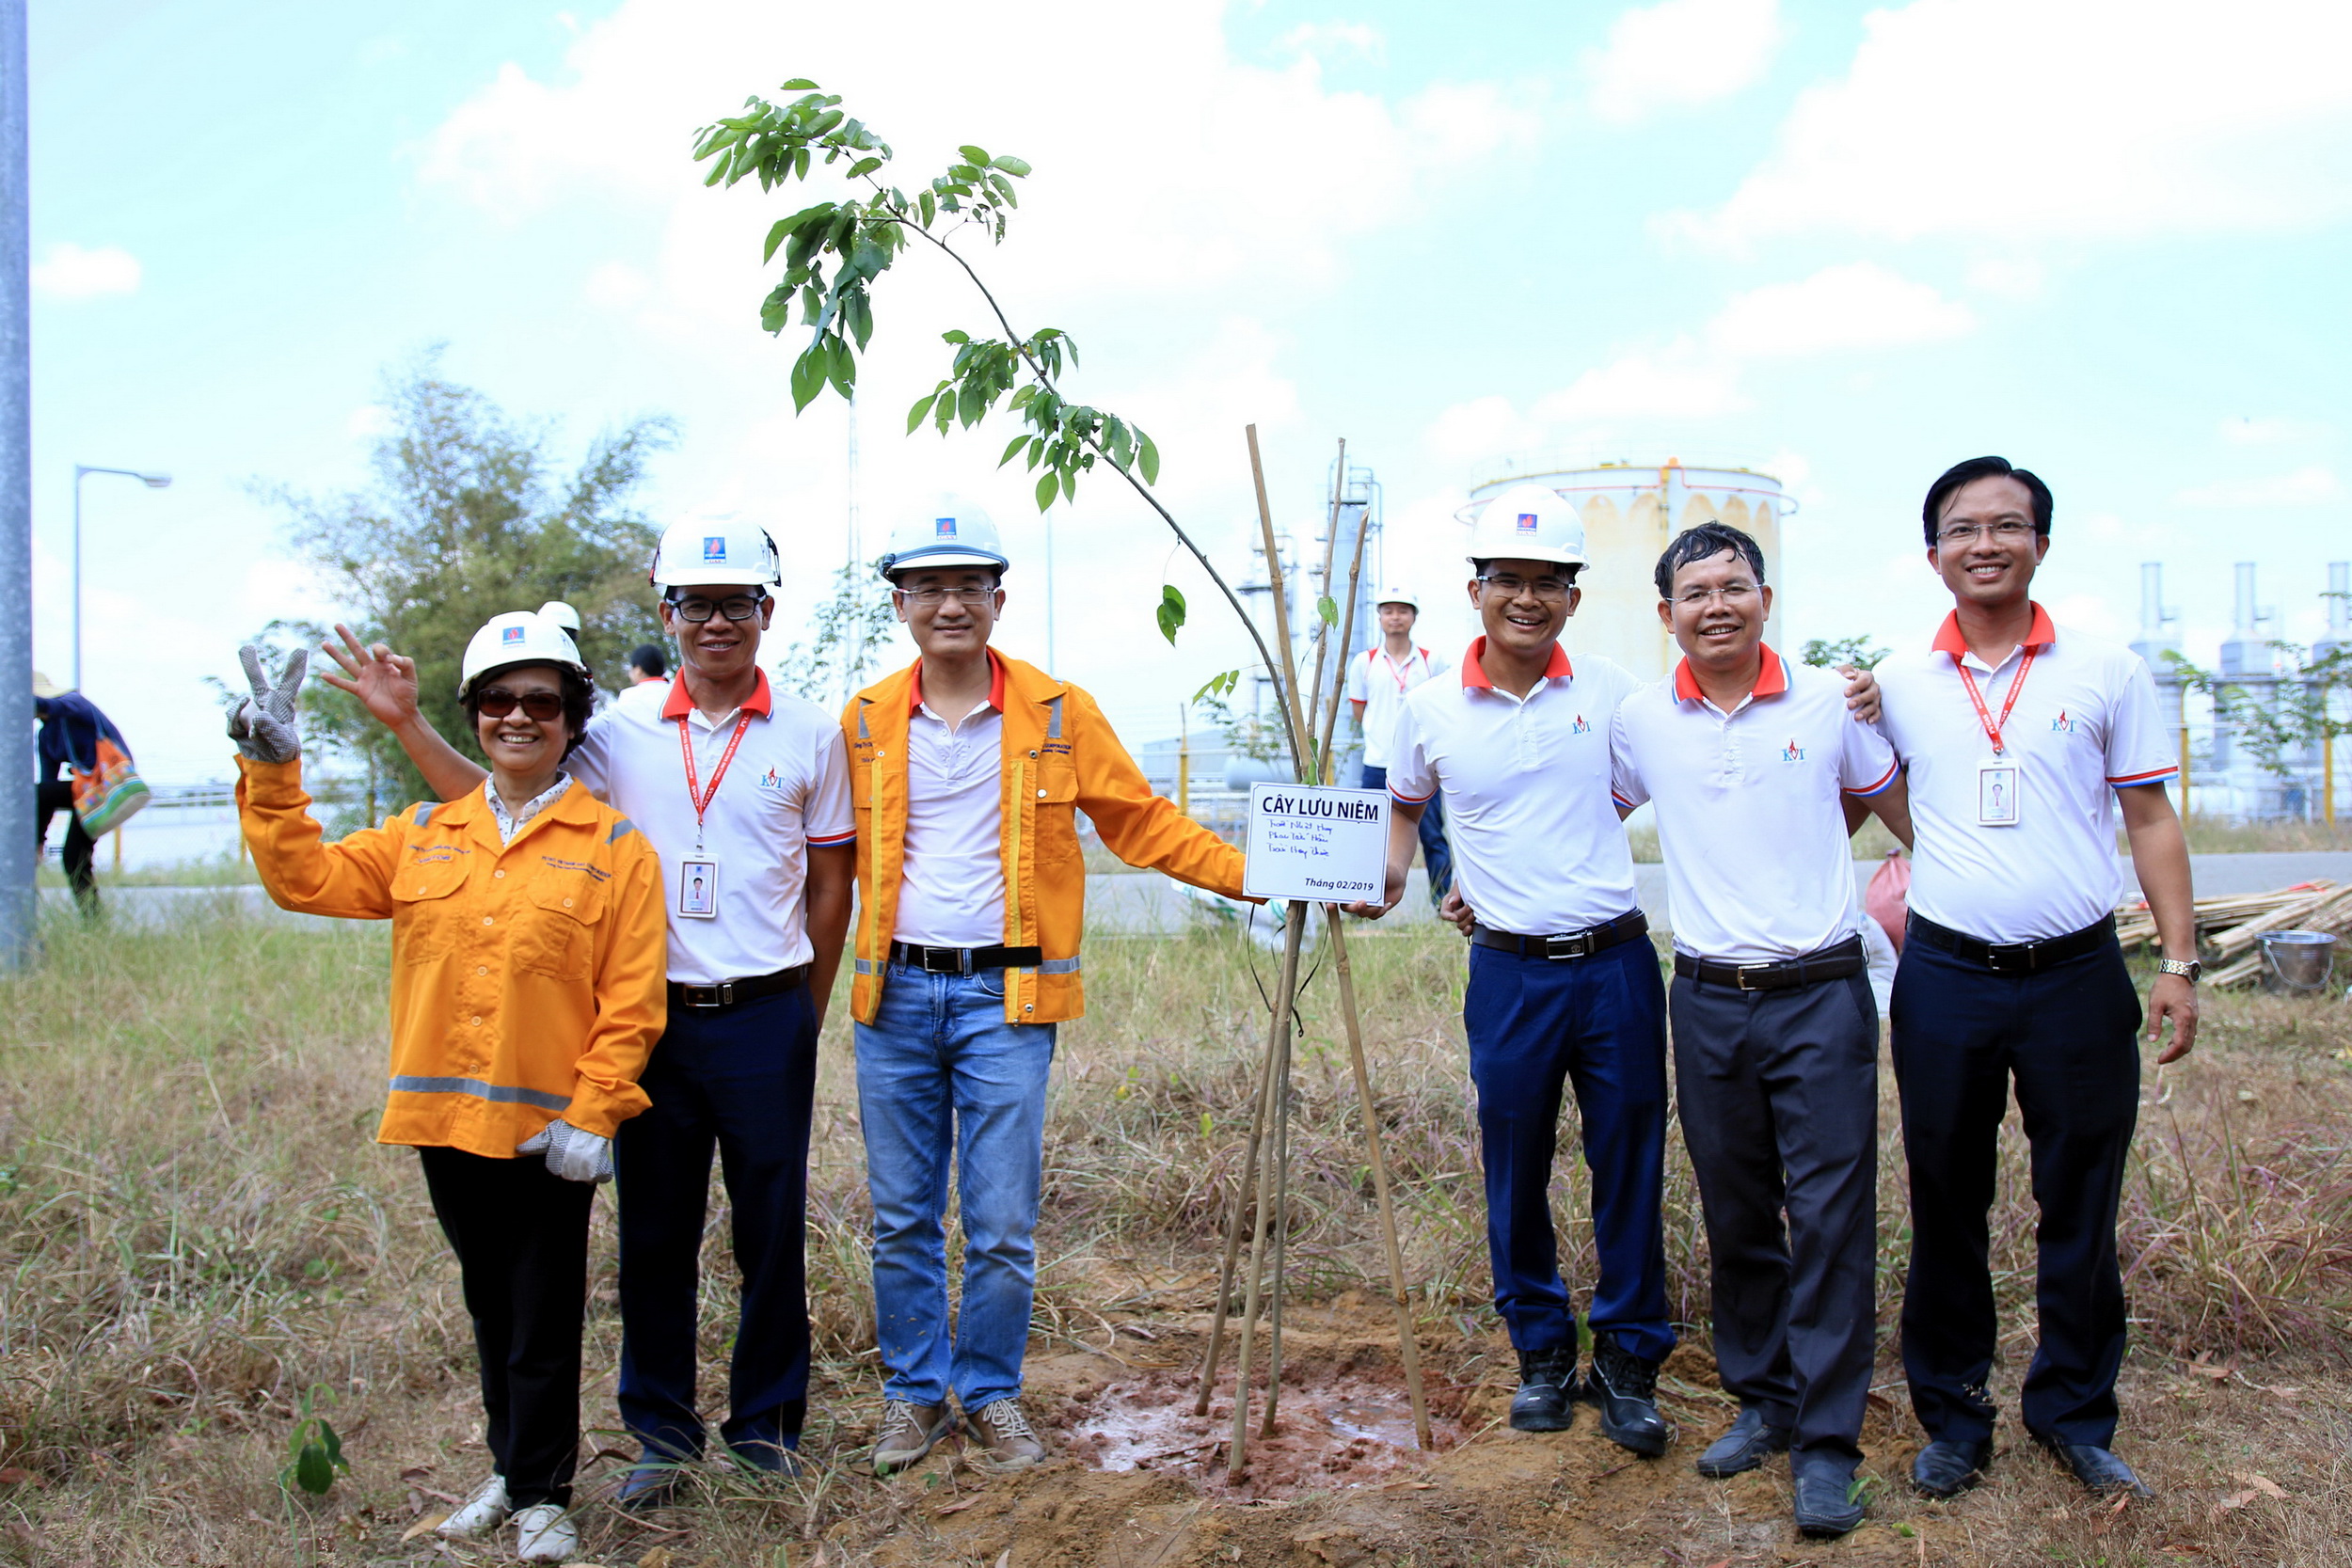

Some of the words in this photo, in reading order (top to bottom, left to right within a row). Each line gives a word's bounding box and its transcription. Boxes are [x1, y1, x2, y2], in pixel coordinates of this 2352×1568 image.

[1263, 794, 1295, 814] CÂY
[1298, 798, 1333, 816] LƯU
[1337, 800, 1378, 824] NIỆM
[1305, 878, 1335, 890] Tháng
[1336, 880, 1374, 891] 02/2019
